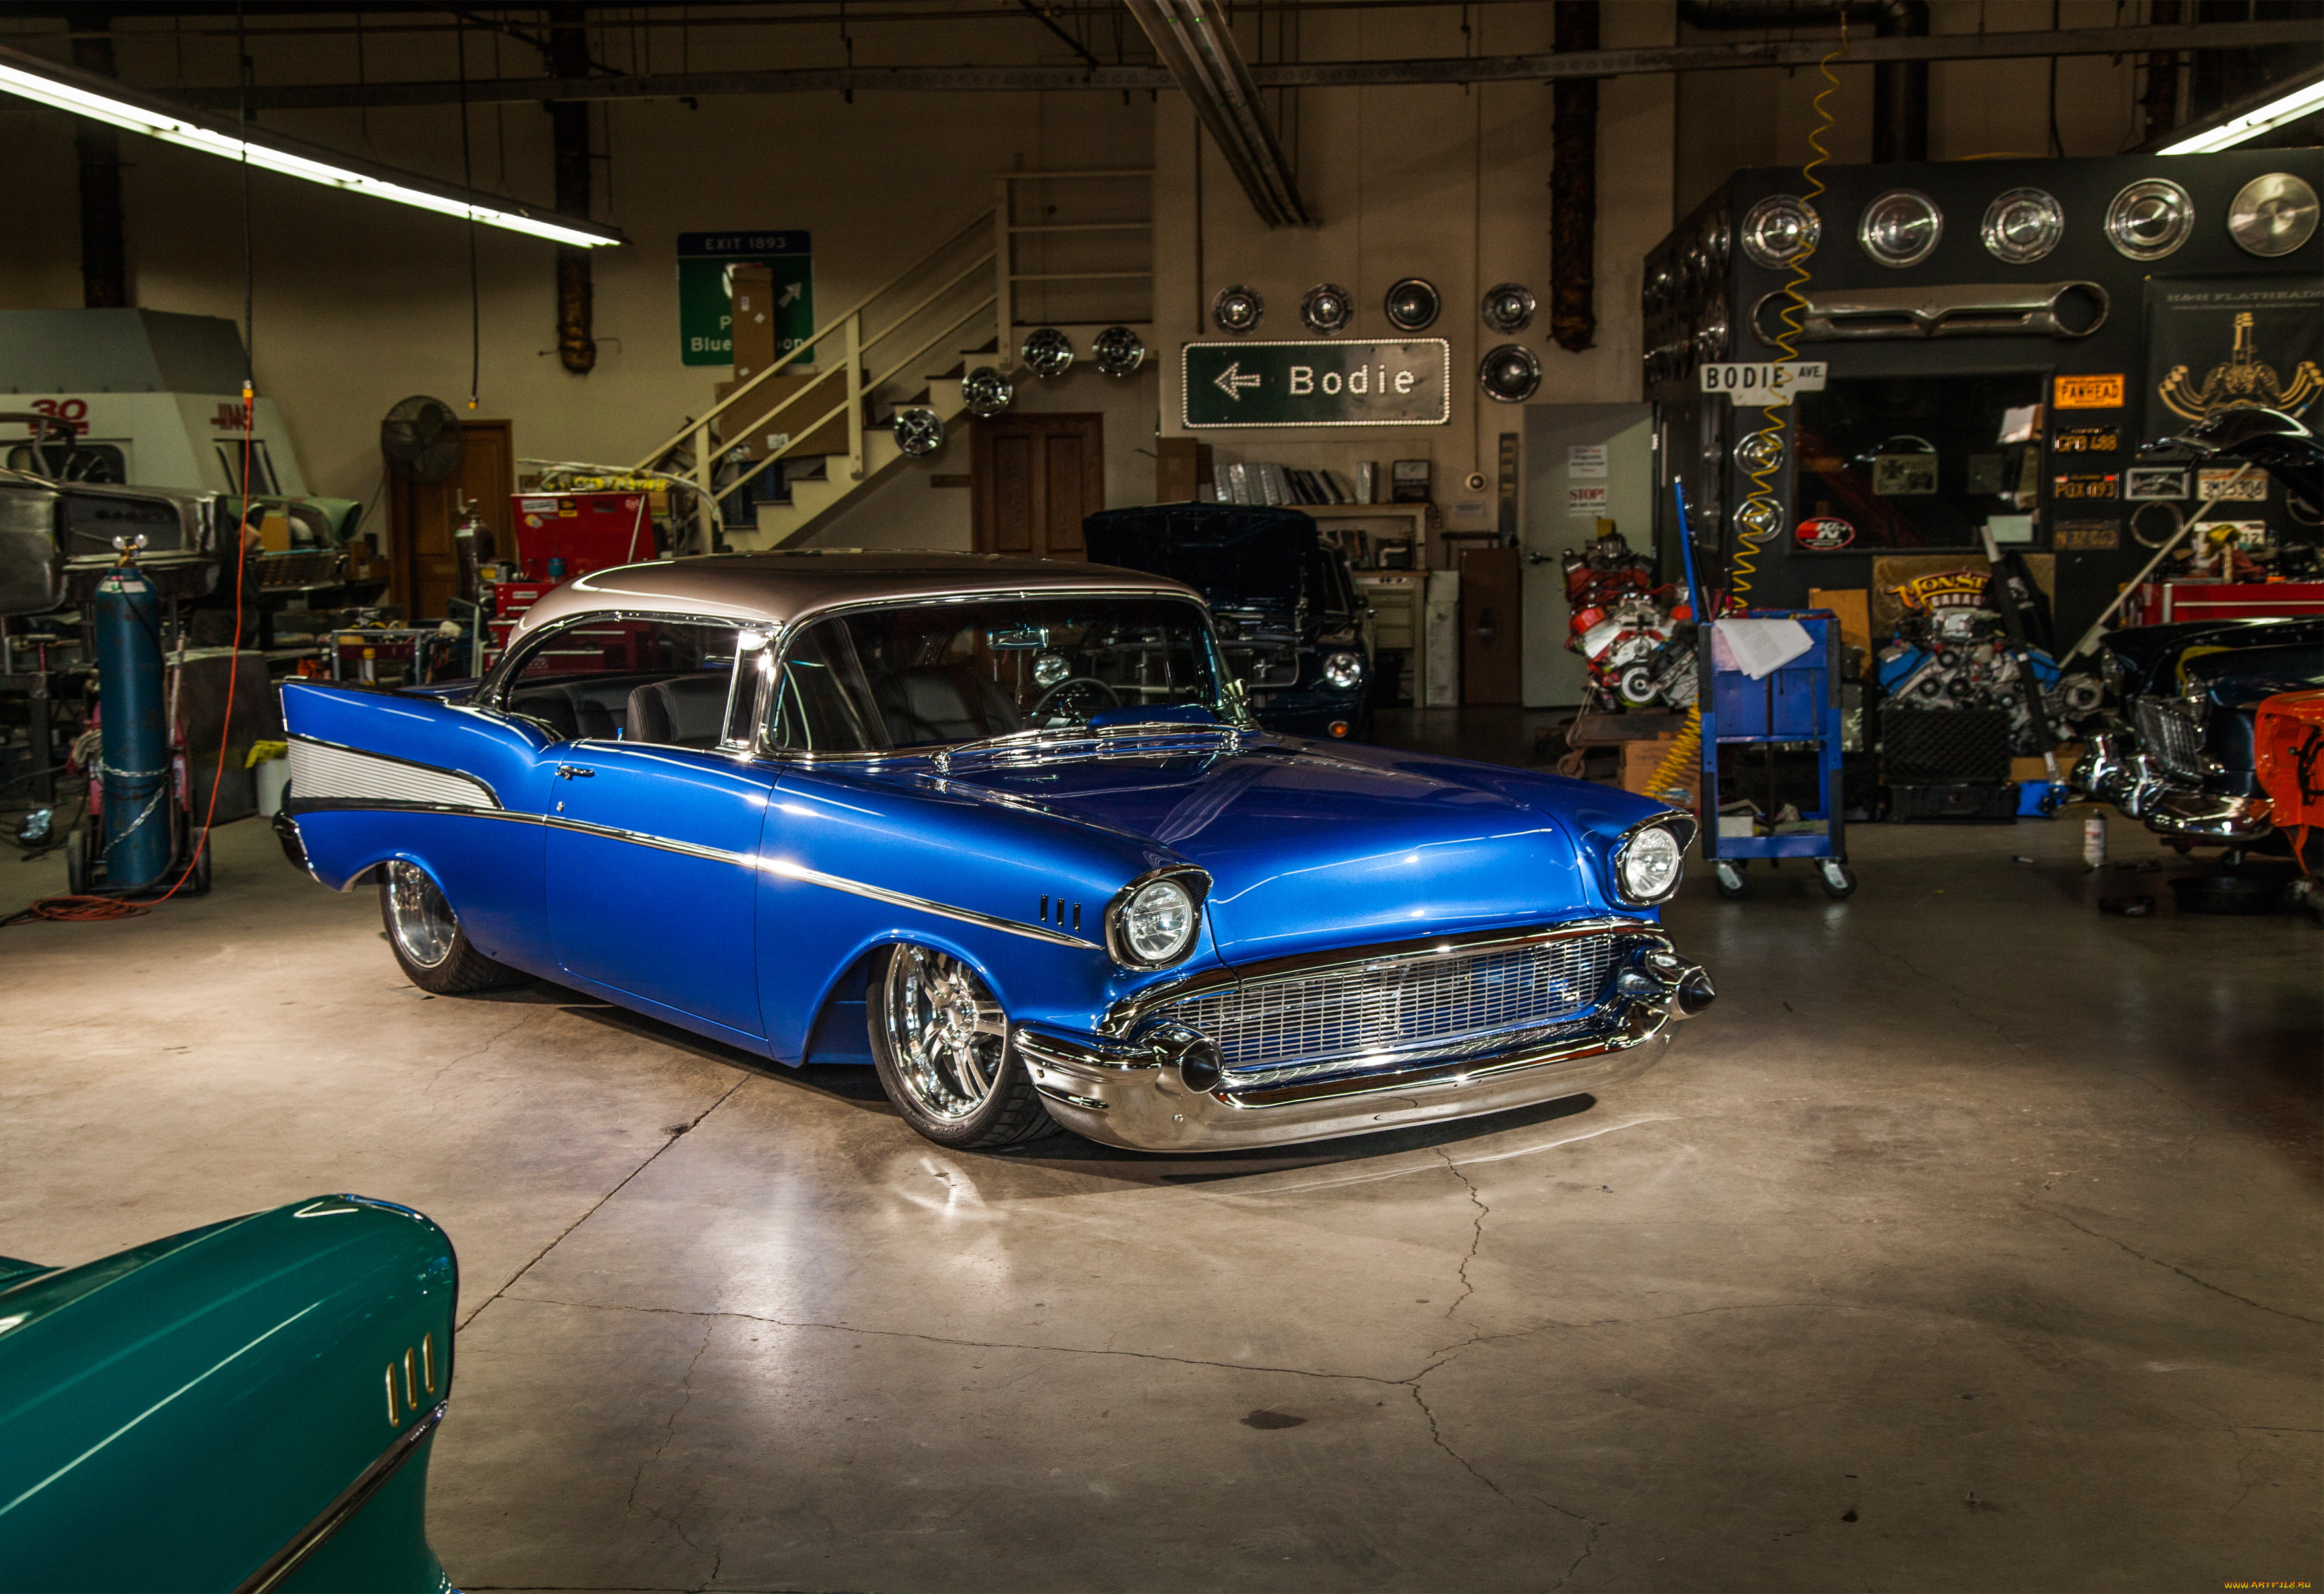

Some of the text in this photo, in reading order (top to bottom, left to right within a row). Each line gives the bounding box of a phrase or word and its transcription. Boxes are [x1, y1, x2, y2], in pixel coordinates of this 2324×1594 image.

[705, 236, 786, 250] EXIT 1893
[691, 337, 732, 352] Blue
[1288, 363, 1415, 395] Bodie
[1706, 366, 1784, 389] BODIE
[1882, 574, 1990, 609] MONST
[1931, 594, 1985, 608] GARAG
